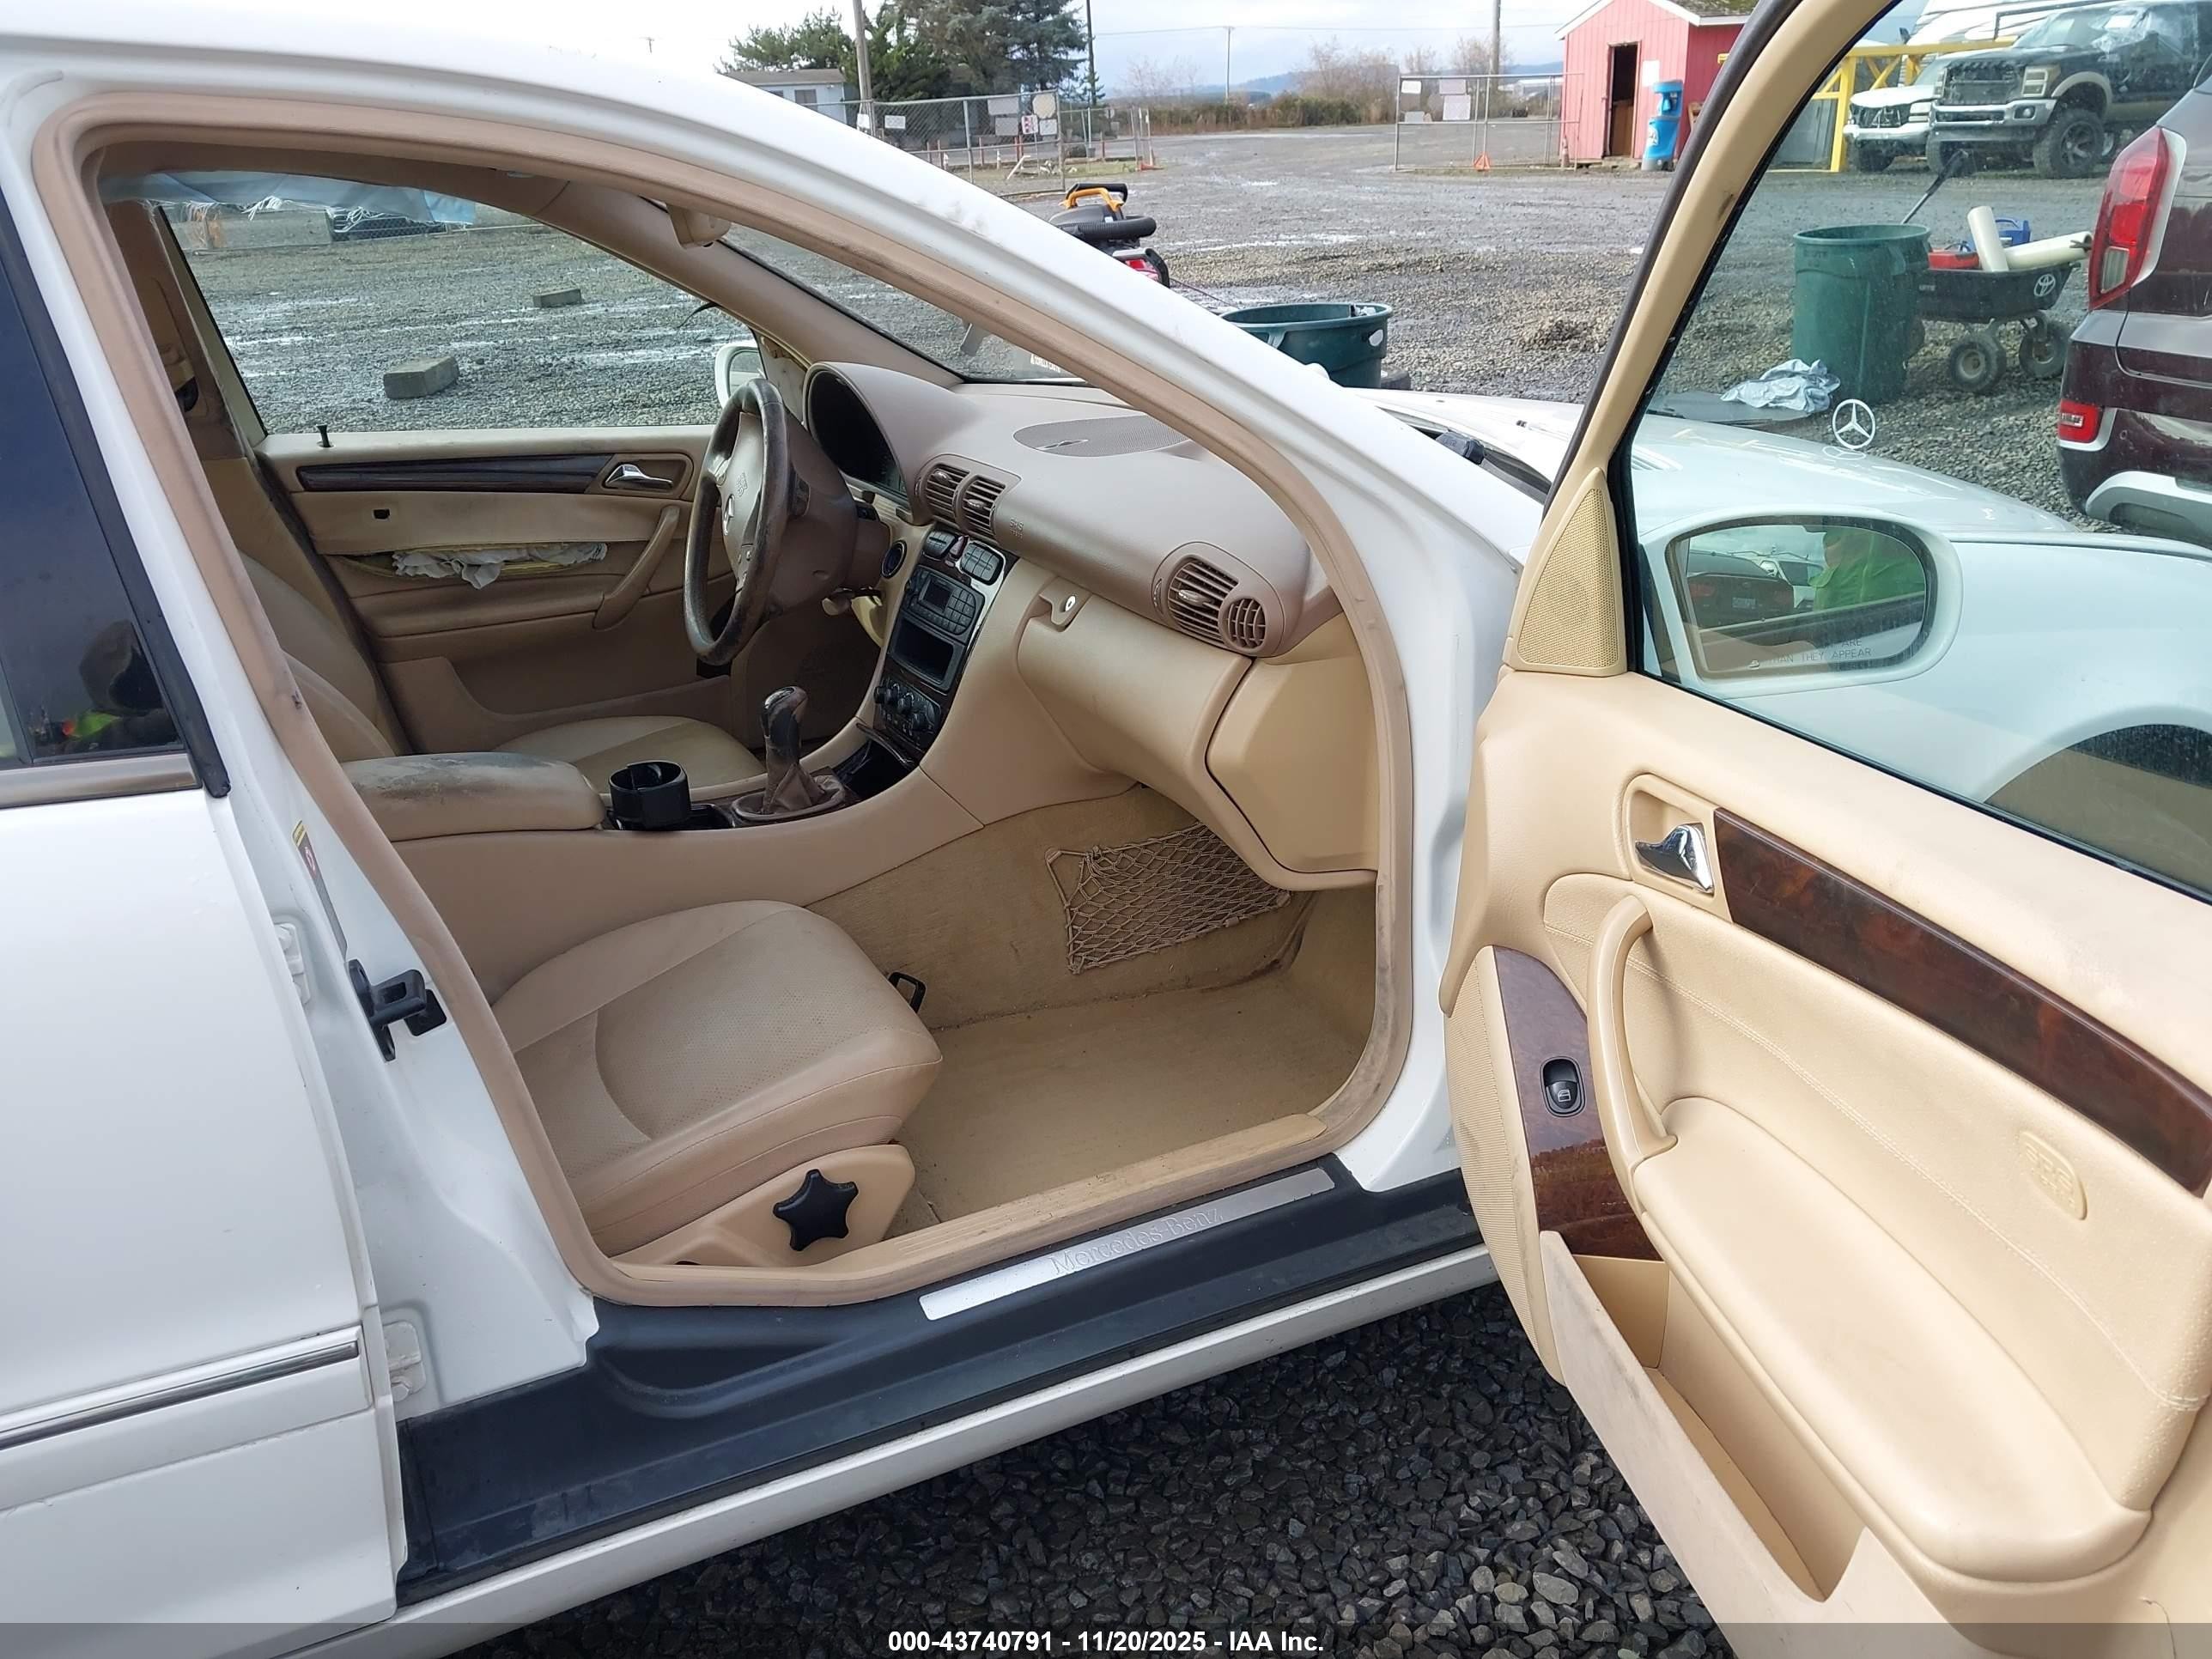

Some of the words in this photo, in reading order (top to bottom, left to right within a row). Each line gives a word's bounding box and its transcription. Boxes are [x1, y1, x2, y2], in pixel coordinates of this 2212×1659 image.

[1842, 638, 1863, 647] ARE
[1832, 647, 1872, 660] APPEAR
[1048, 1207, 1224, 1275] Mercedes-Benz
